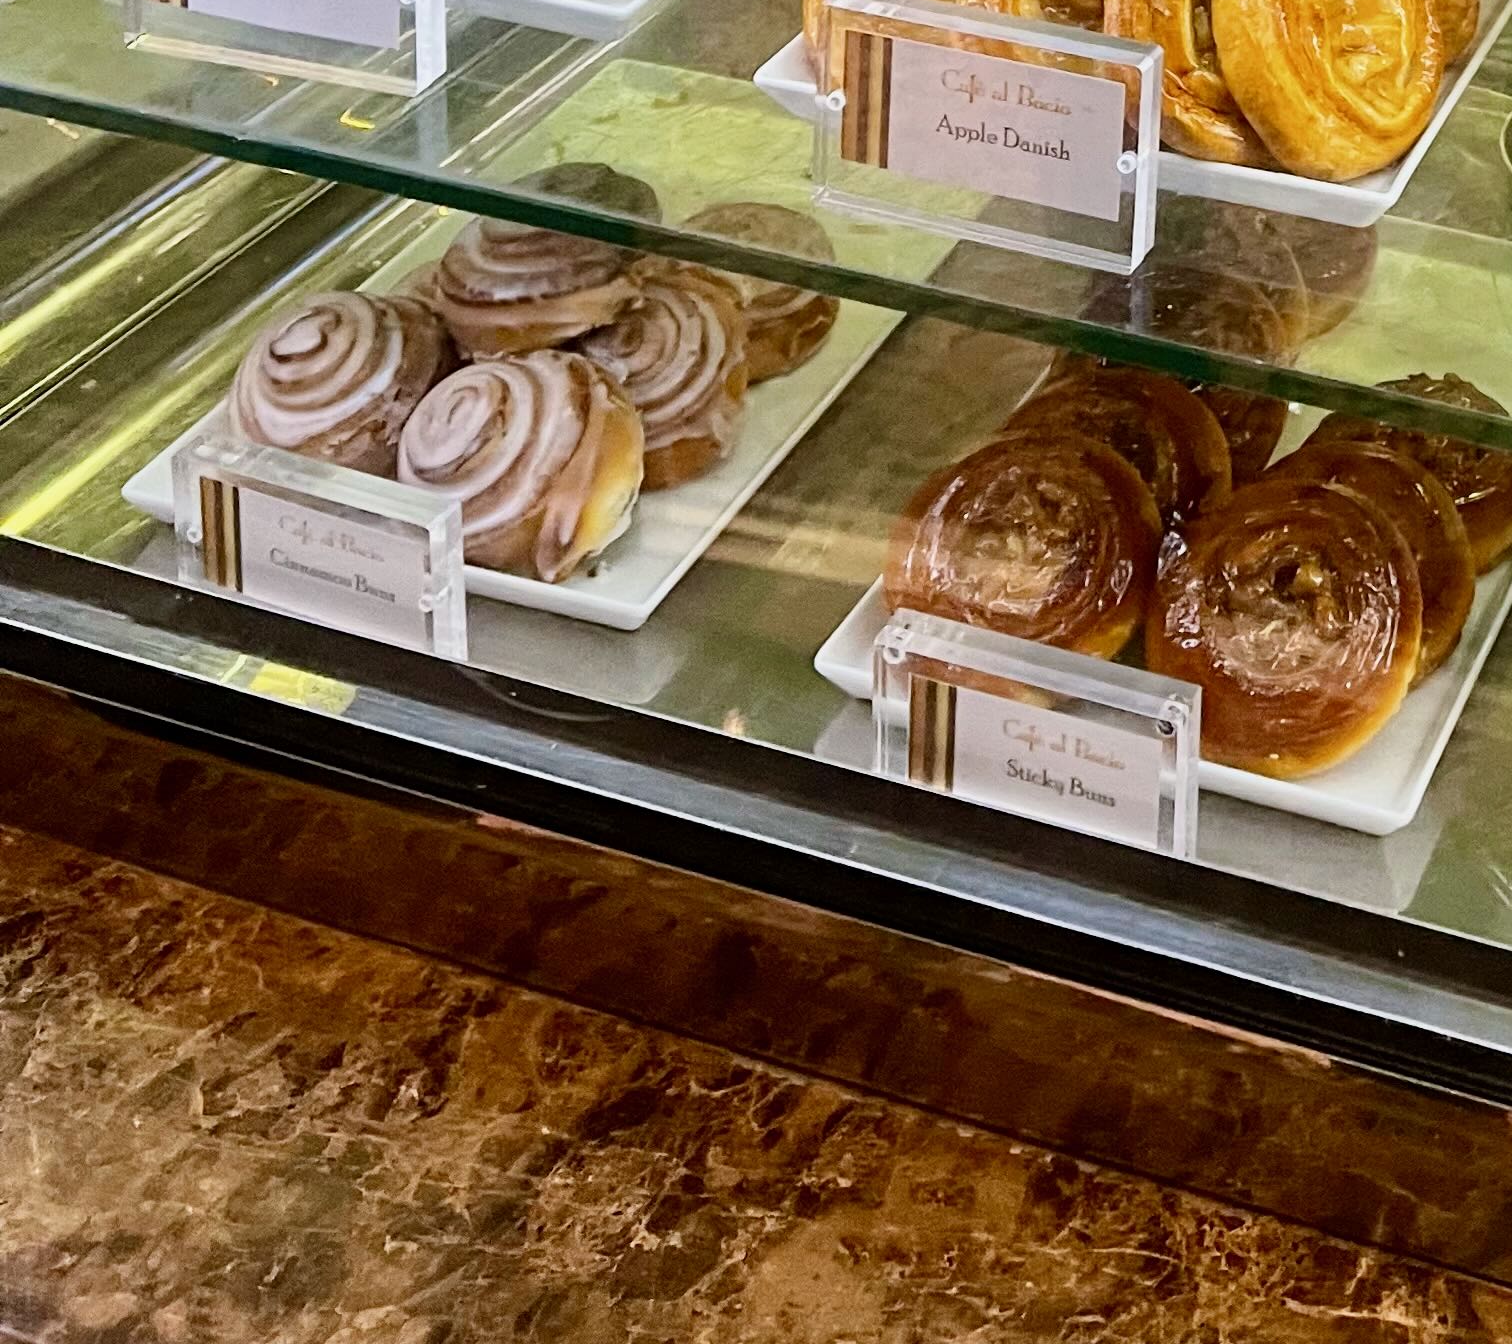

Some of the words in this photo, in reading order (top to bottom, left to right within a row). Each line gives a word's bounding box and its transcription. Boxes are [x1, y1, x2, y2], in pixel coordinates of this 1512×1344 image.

[991, 81, 1008, 102] al
[1018, 84, 1072, 116] Bacio
[936, 113, 998, 145] Apple
[1003, 127, 1071, 162] Danish
[1006, 759, 1065, 795] Sticky
[1069, 777, 1115, 807] Buns
